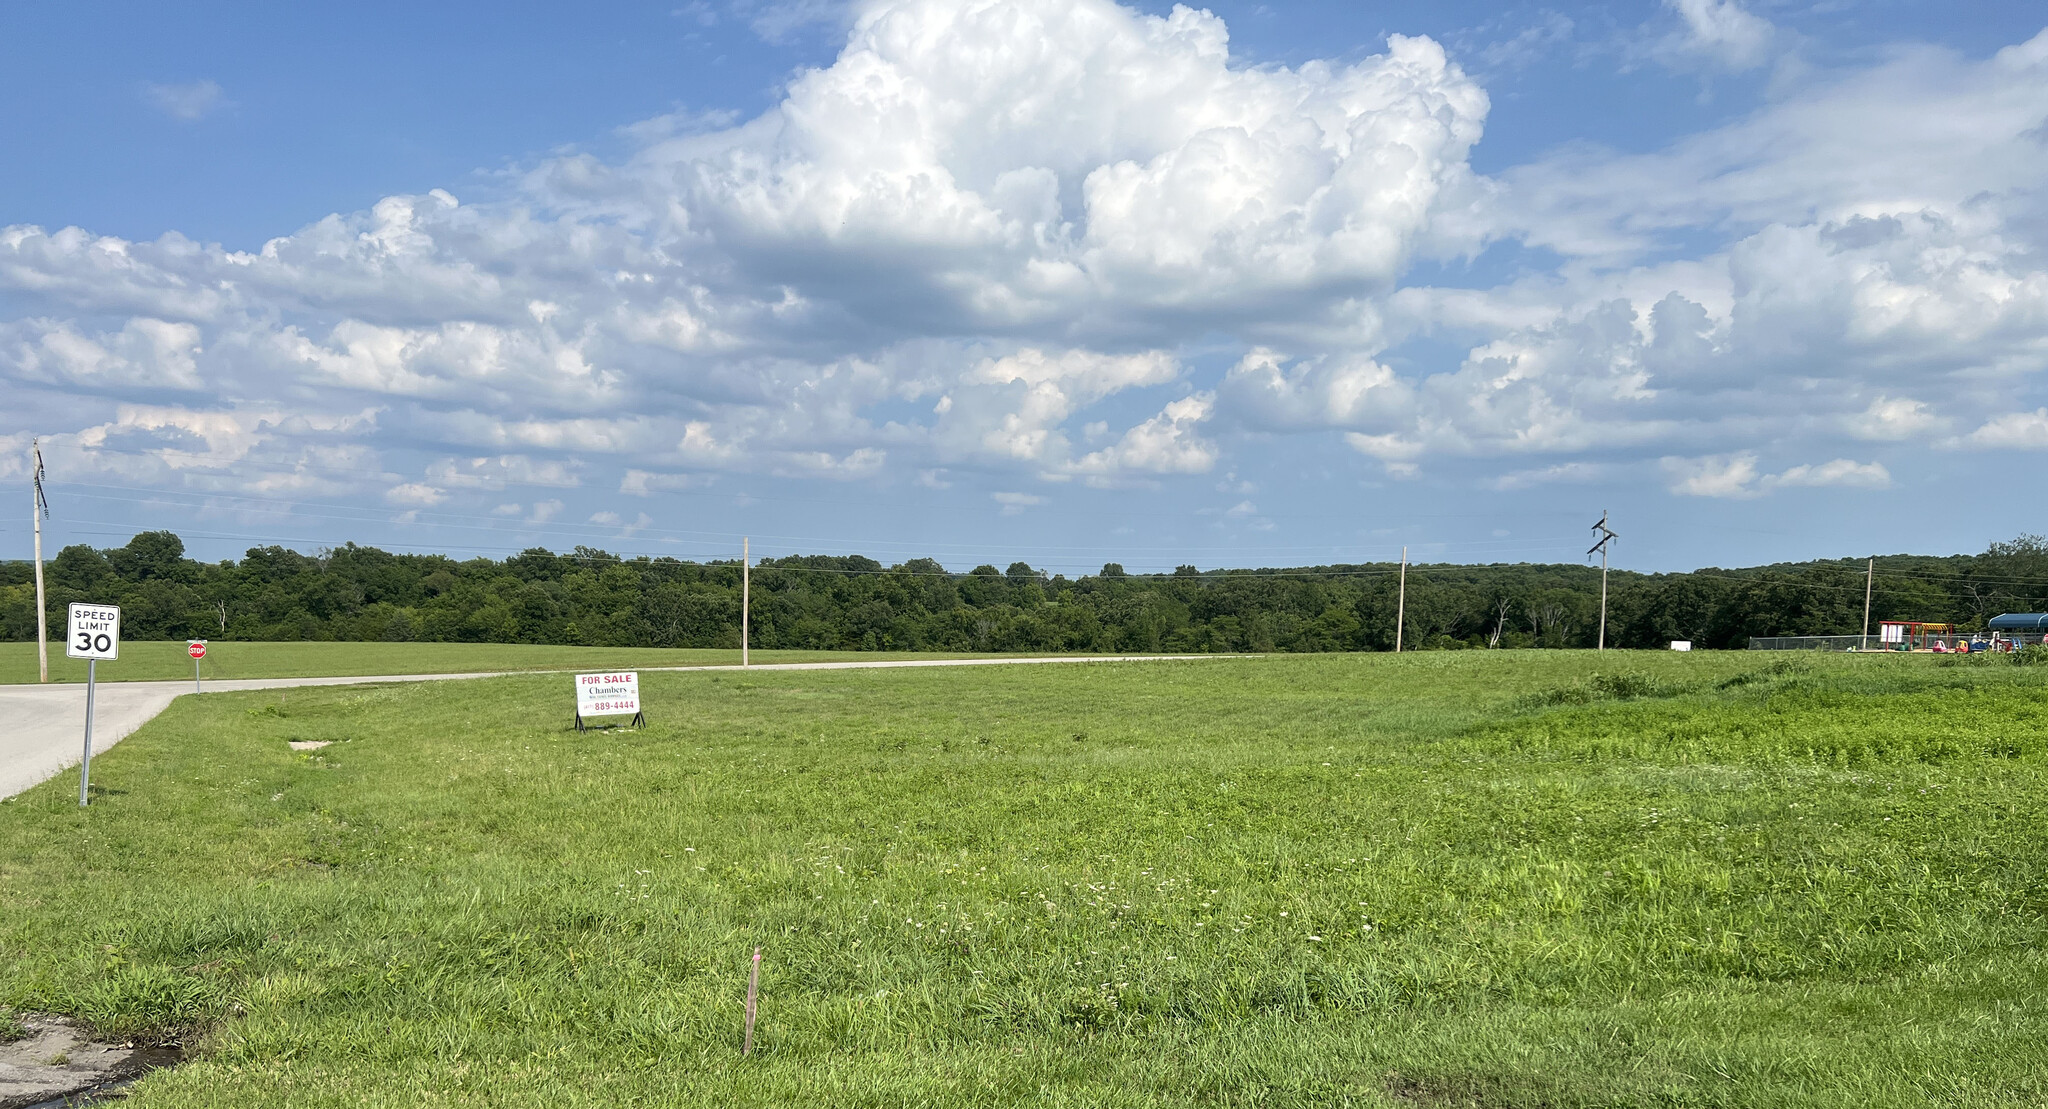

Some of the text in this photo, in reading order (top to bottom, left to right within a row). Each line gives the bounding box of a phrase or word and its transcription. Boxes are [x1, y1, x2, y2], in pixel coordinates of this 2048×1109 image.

[74, 610, 115, 621] SPEED
[78, 621, 110, 631] LIMIT
[75, 632, 112, 652] 30
[582, 674, 632, 685] FOR SALE
[589, 686, 627, 695] Chambers
[595, 701, 634, 711] 889-4444
